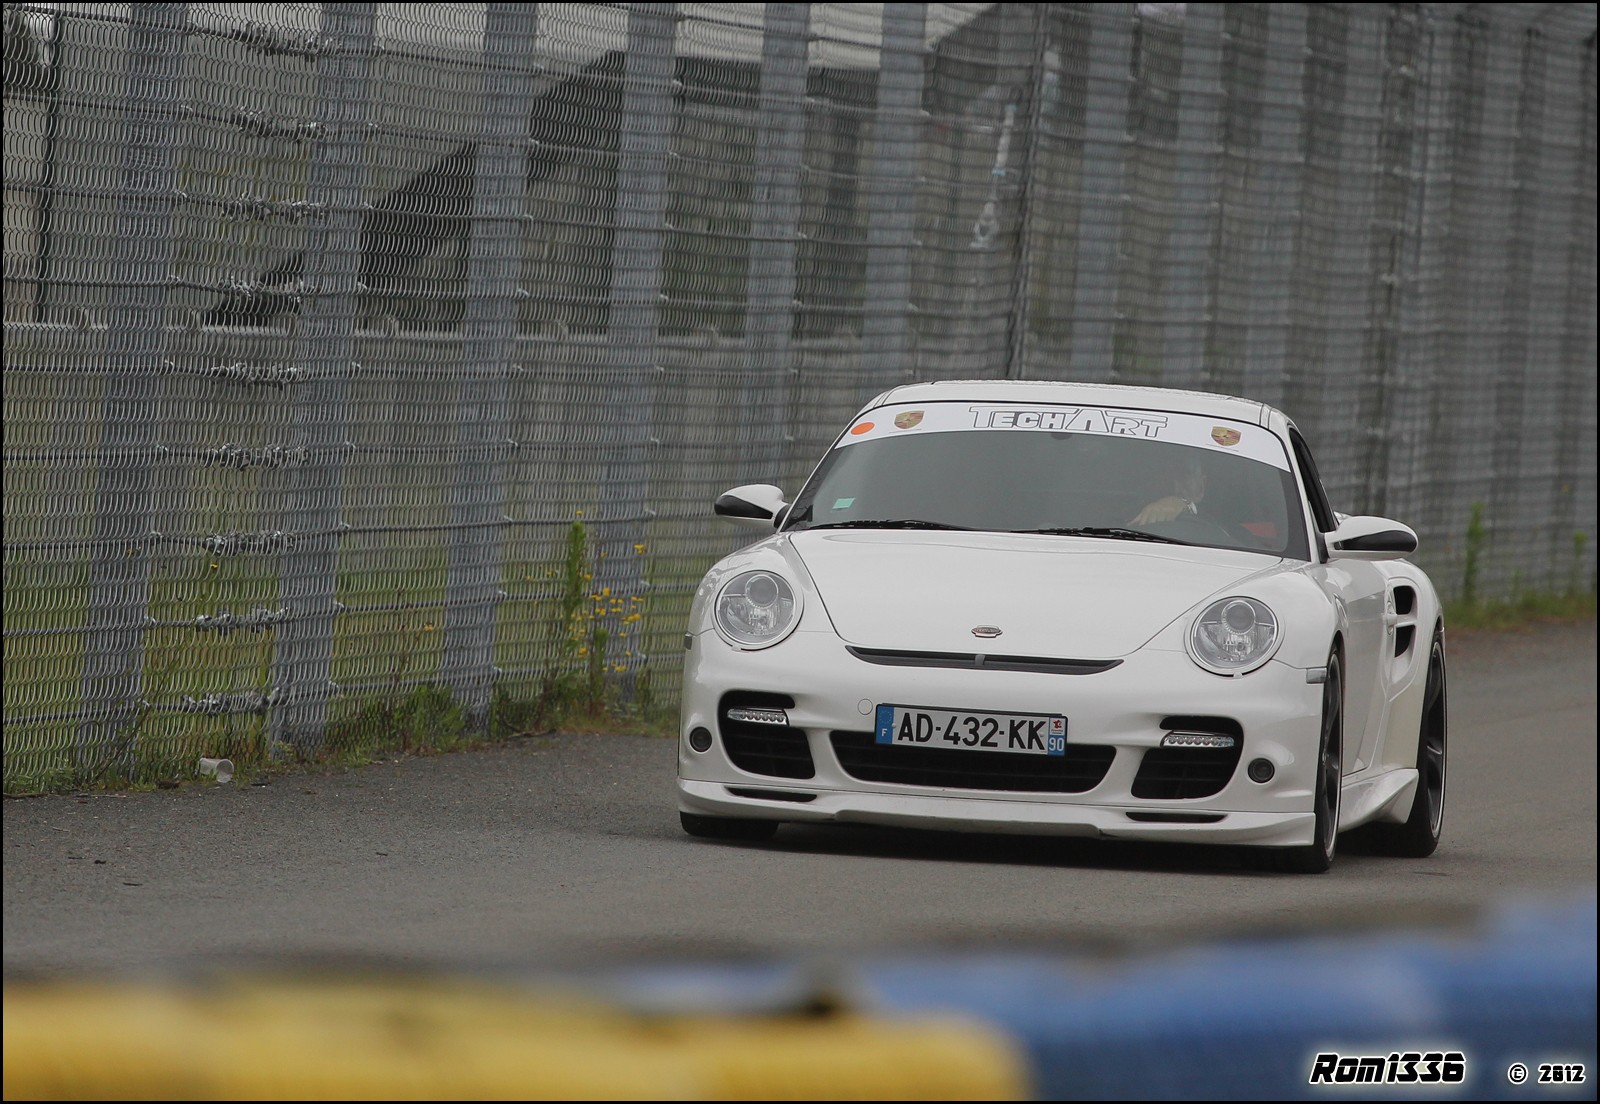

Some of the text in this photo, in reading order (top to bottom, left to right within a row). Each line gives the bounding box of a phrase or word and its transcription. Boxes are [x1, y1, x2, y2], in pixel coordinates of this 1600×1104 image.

[969, 405, 1168, 438] TECHART
[881, 728, 888, 737] F
[897, 712, 1047, 751] AD-432-KK
[1048, 737, 1065, 752] 90
